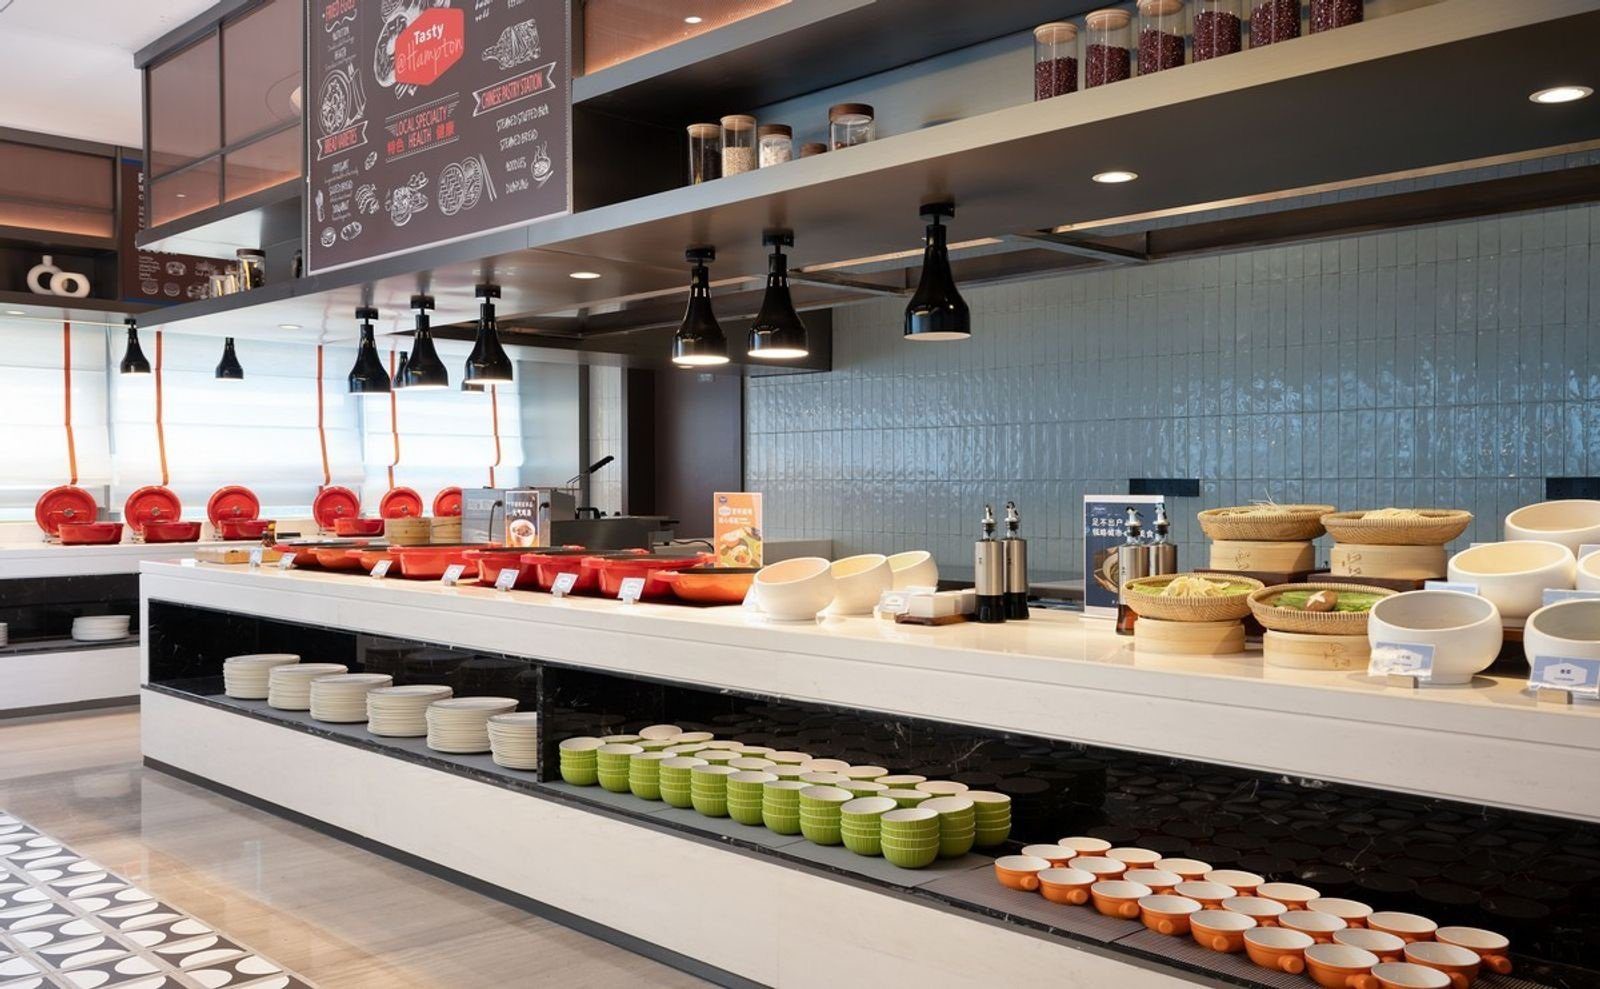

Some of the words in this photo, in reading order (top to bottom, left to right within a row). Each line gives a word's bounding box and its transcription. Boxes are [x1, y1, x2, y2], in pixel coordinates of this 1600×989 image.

[413, 24, 444, 45] Tasty
[397, 38, 463, 75] @Hampton
[520, 71, 543, 96] STATION
[396, 116, 415, 137] LOCAL
[415, 104, 448, 129] SPECIALTY
[408, 127, 432, 148] HEALTH
[1092, 517, 1123, 527] 足不出户
